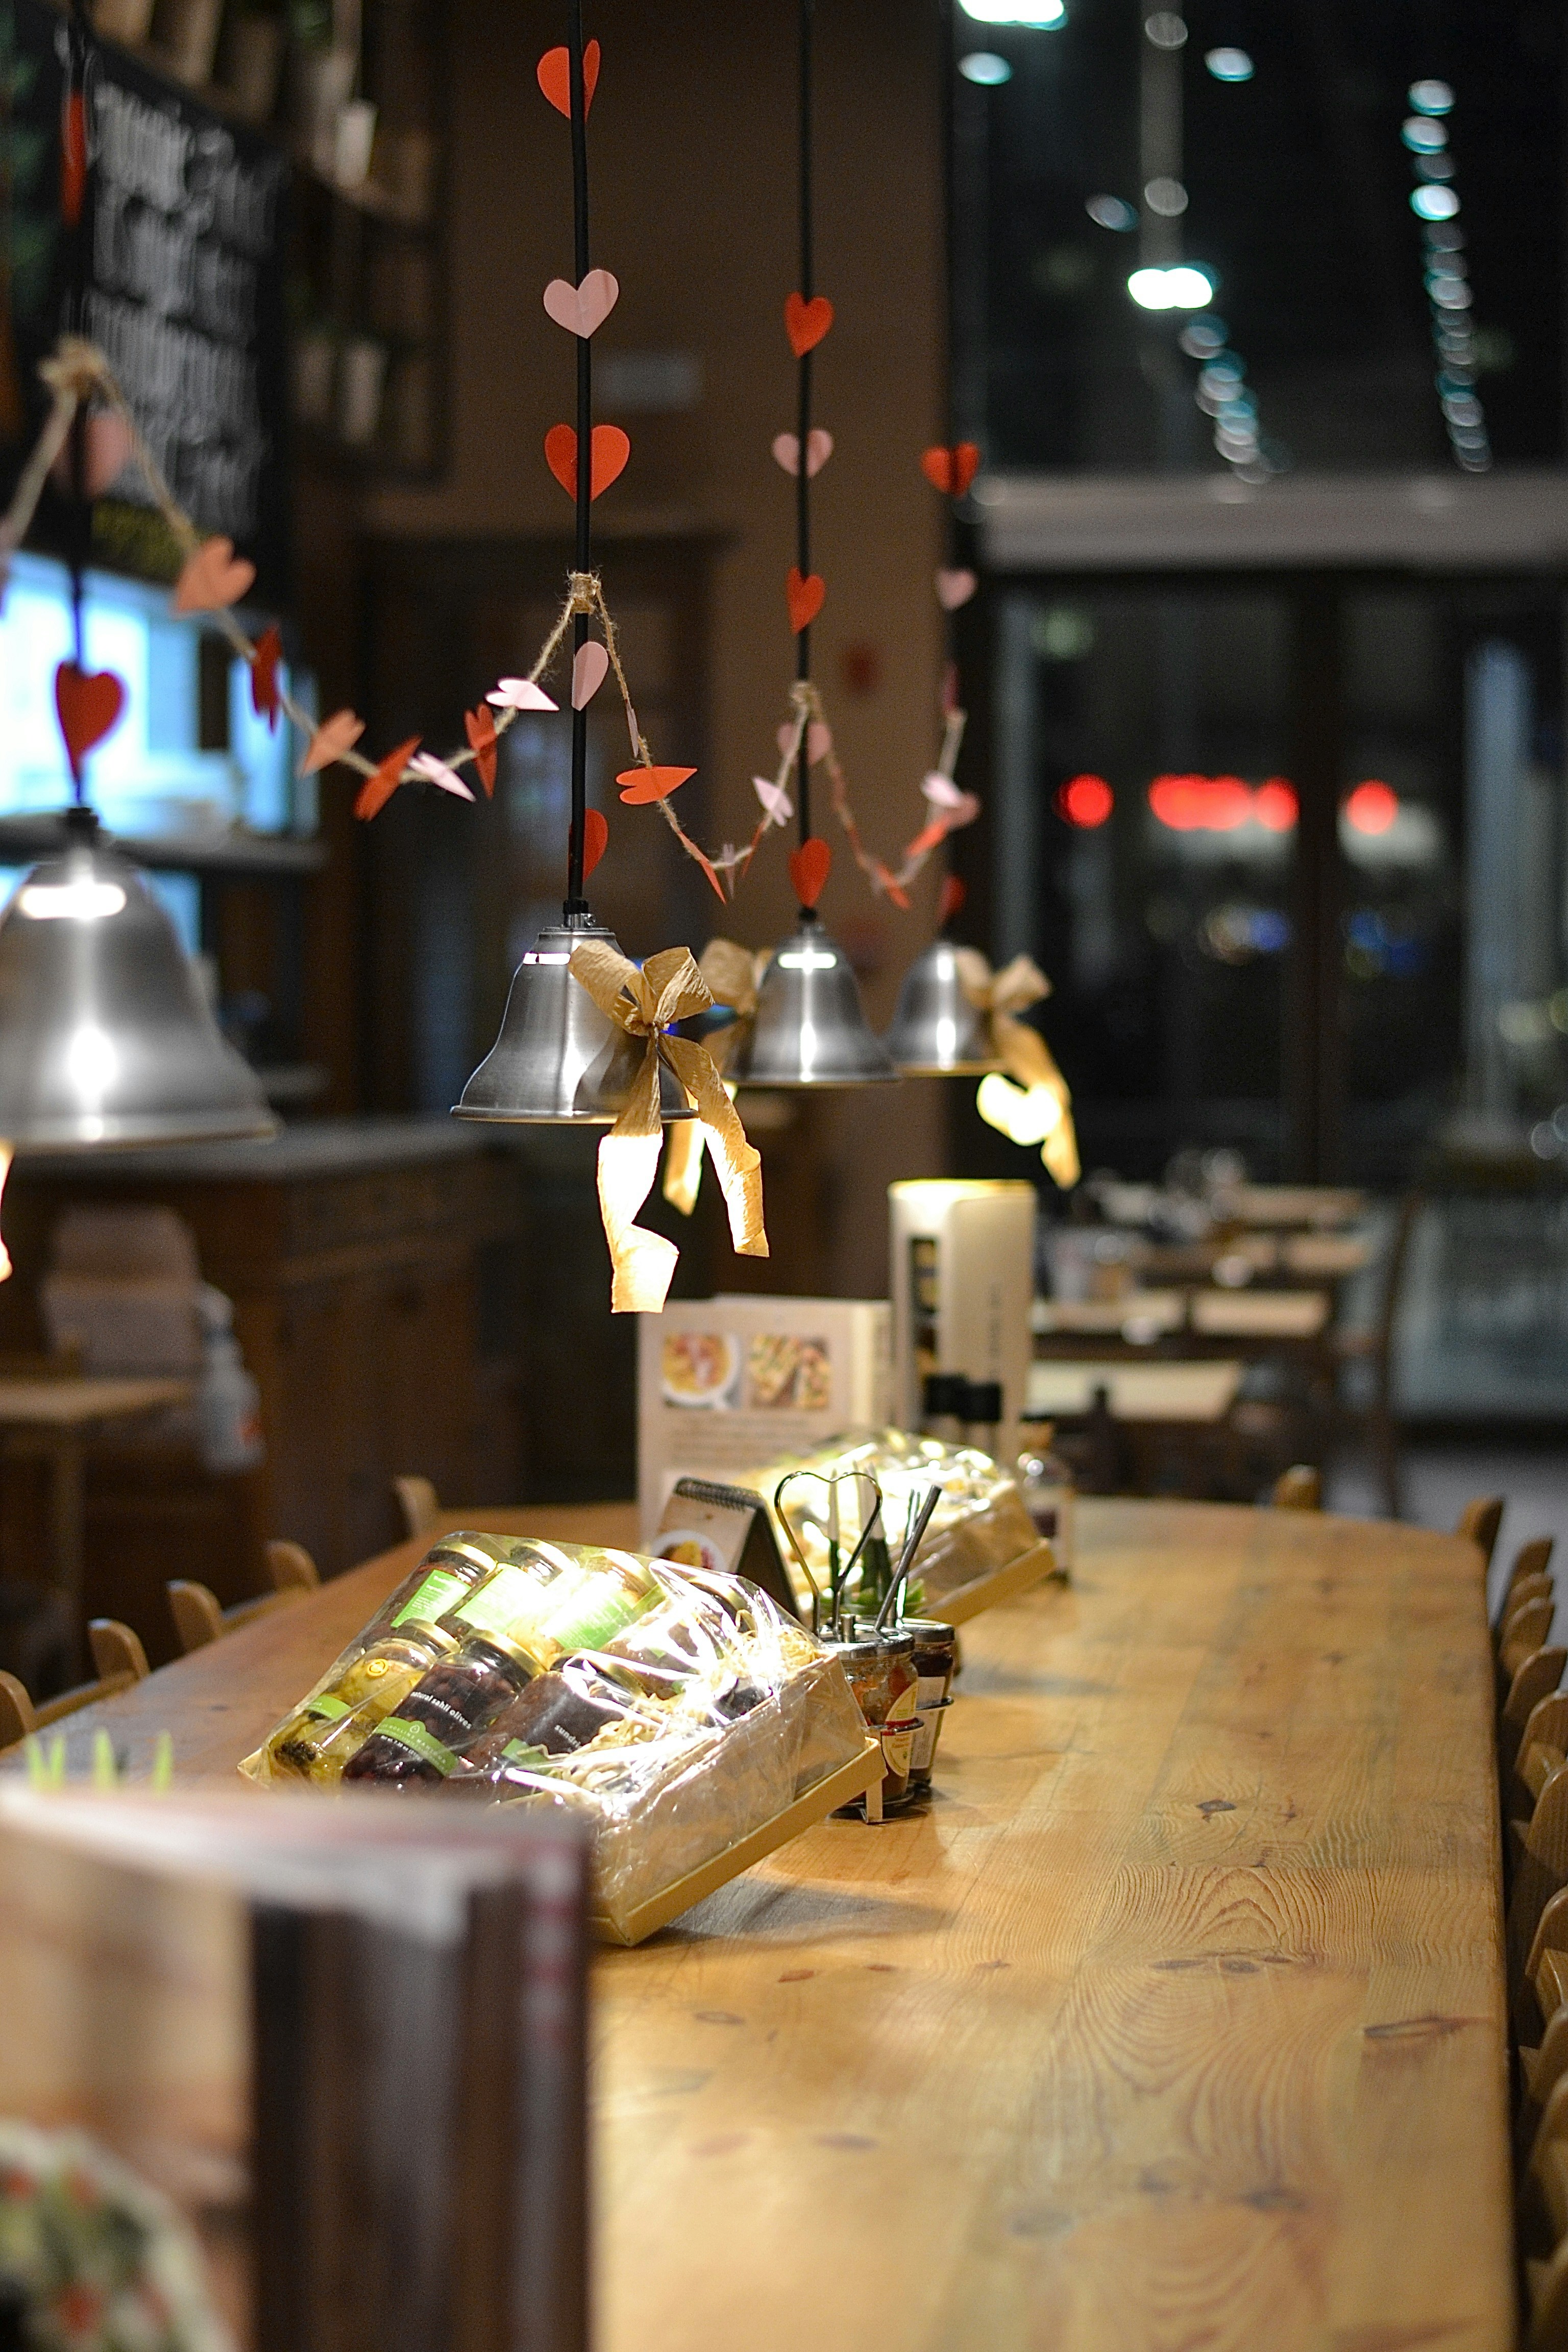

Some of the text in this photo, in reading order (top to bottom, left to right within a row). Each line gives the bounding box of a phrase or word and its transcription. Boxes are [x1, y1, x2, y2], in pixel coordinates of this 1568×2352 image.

[431, 1698, 451, 1712] sahli
[449, 1709, 472, 1729] olives
[554, 1724, 582, 1749] sundri
